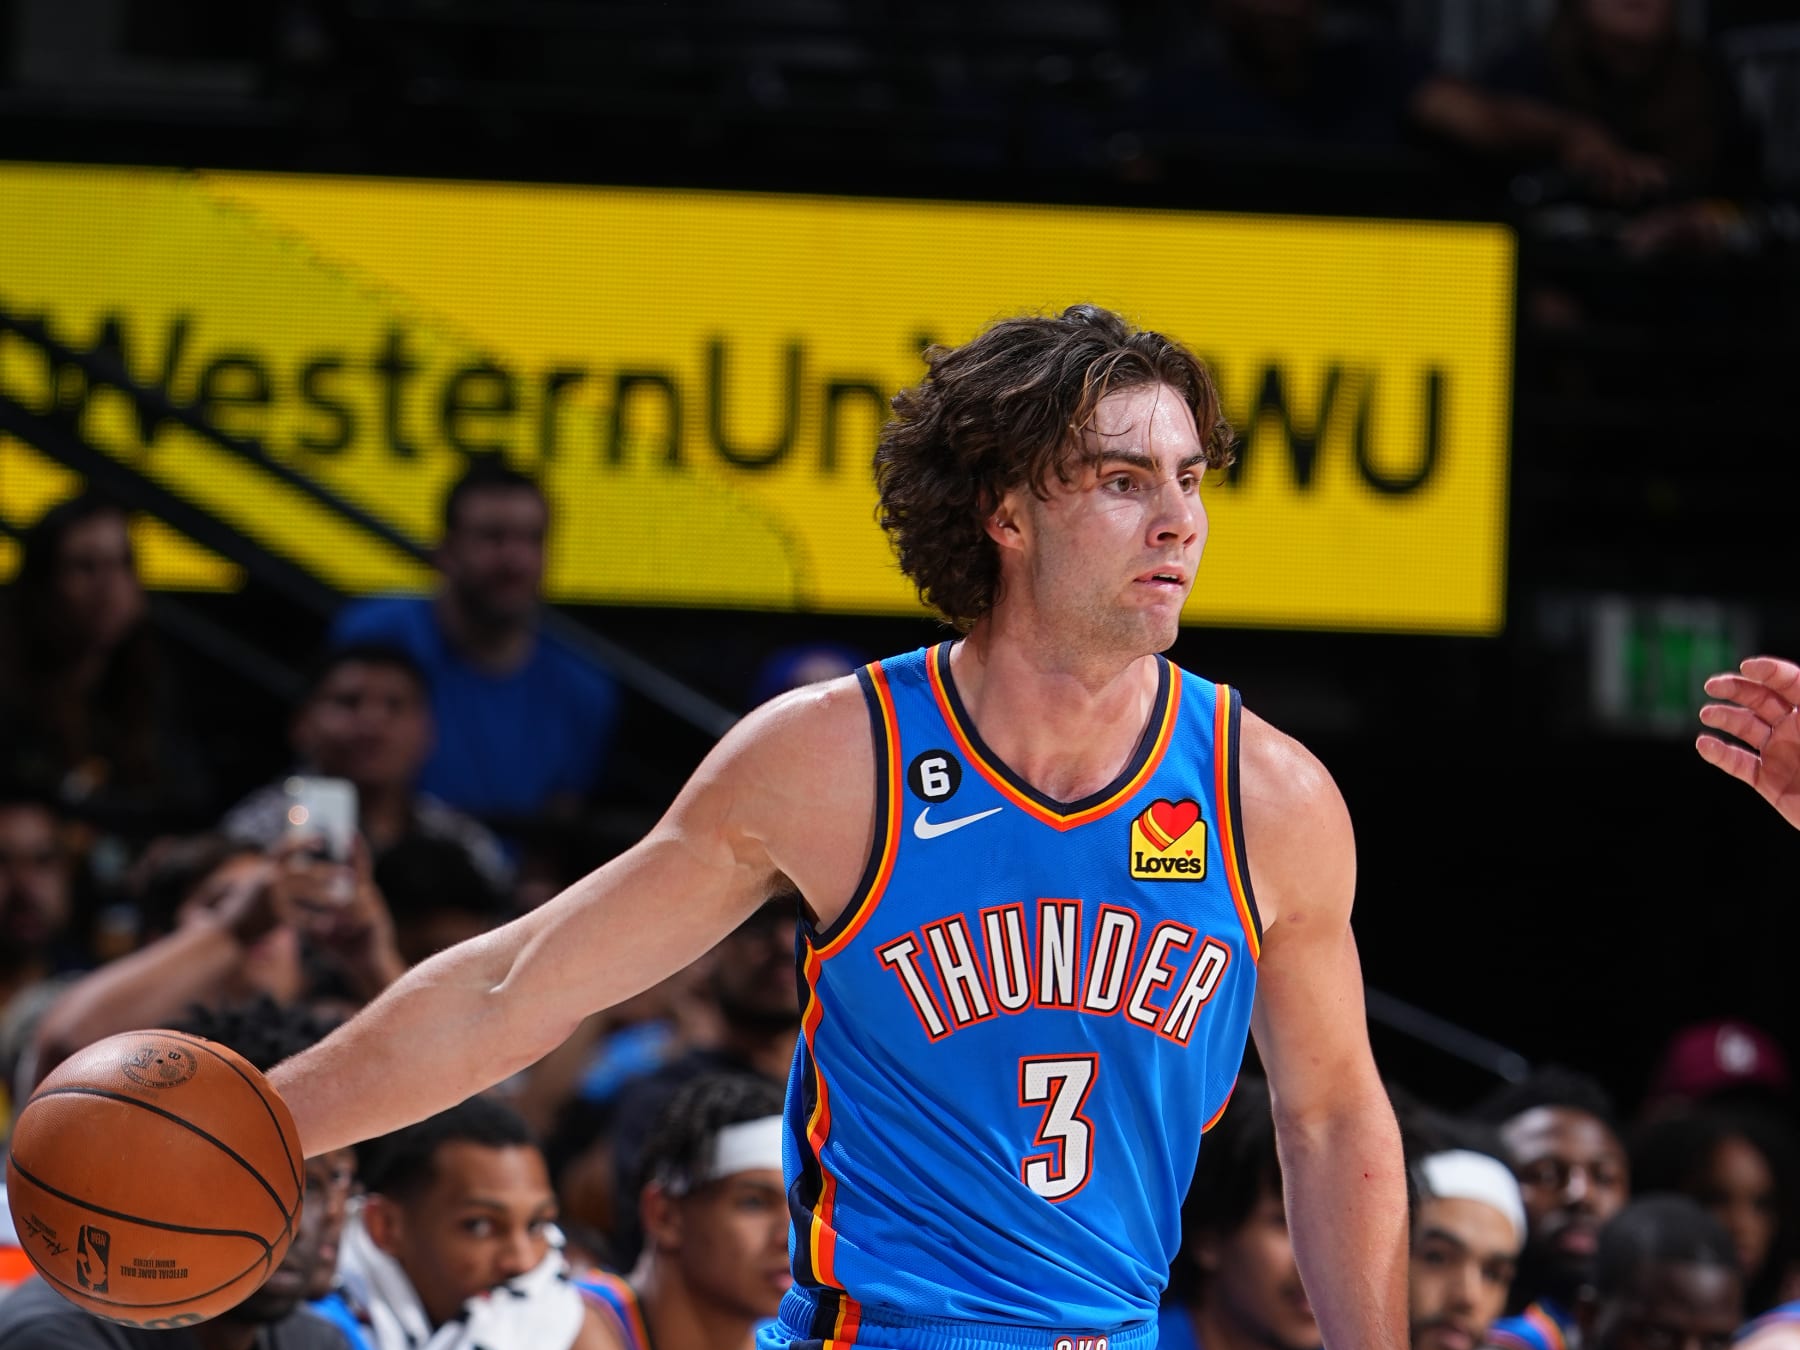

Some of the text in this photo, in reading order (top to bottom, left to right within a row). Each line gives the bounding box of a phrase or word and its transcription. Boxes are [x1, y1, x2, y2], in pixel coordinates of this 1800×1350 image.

[920, 756, 951, 797] 6
[875, 898, 1230, 1048] THUNDER
[1019, 1053, 1099, 1204] 3
